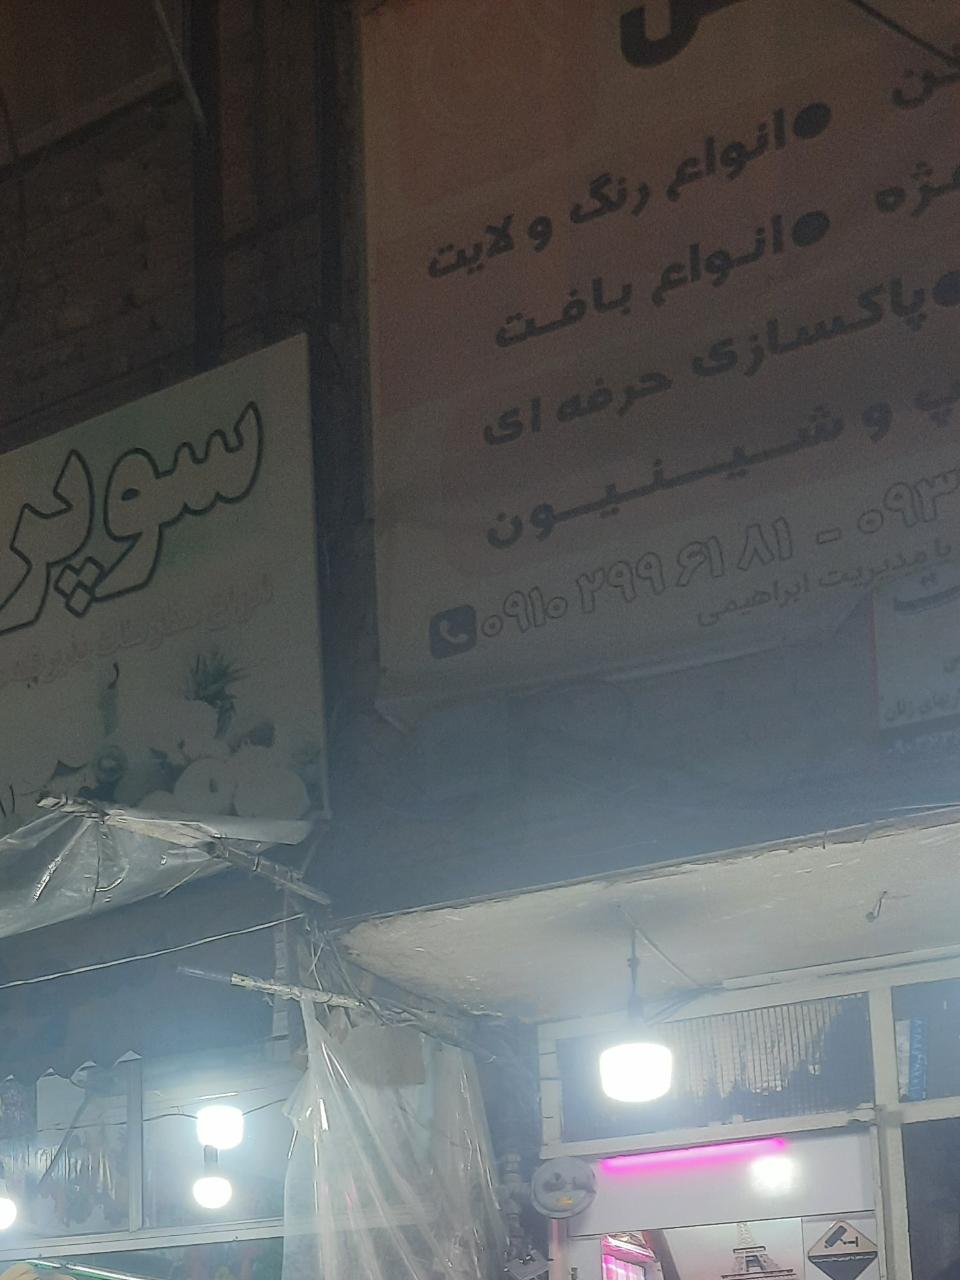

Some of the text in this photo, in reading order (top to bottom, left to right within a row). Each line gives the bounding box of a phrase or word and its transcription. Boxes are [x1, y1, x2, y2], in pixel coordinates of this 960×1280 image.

[428, 107, 787, 280] انواع رنگ و لایت
[496, 213, 784, 349] انواع بافت
[691, 276, 926, 379] پاکسازی
[486, 404, 844, 550] شینیون
